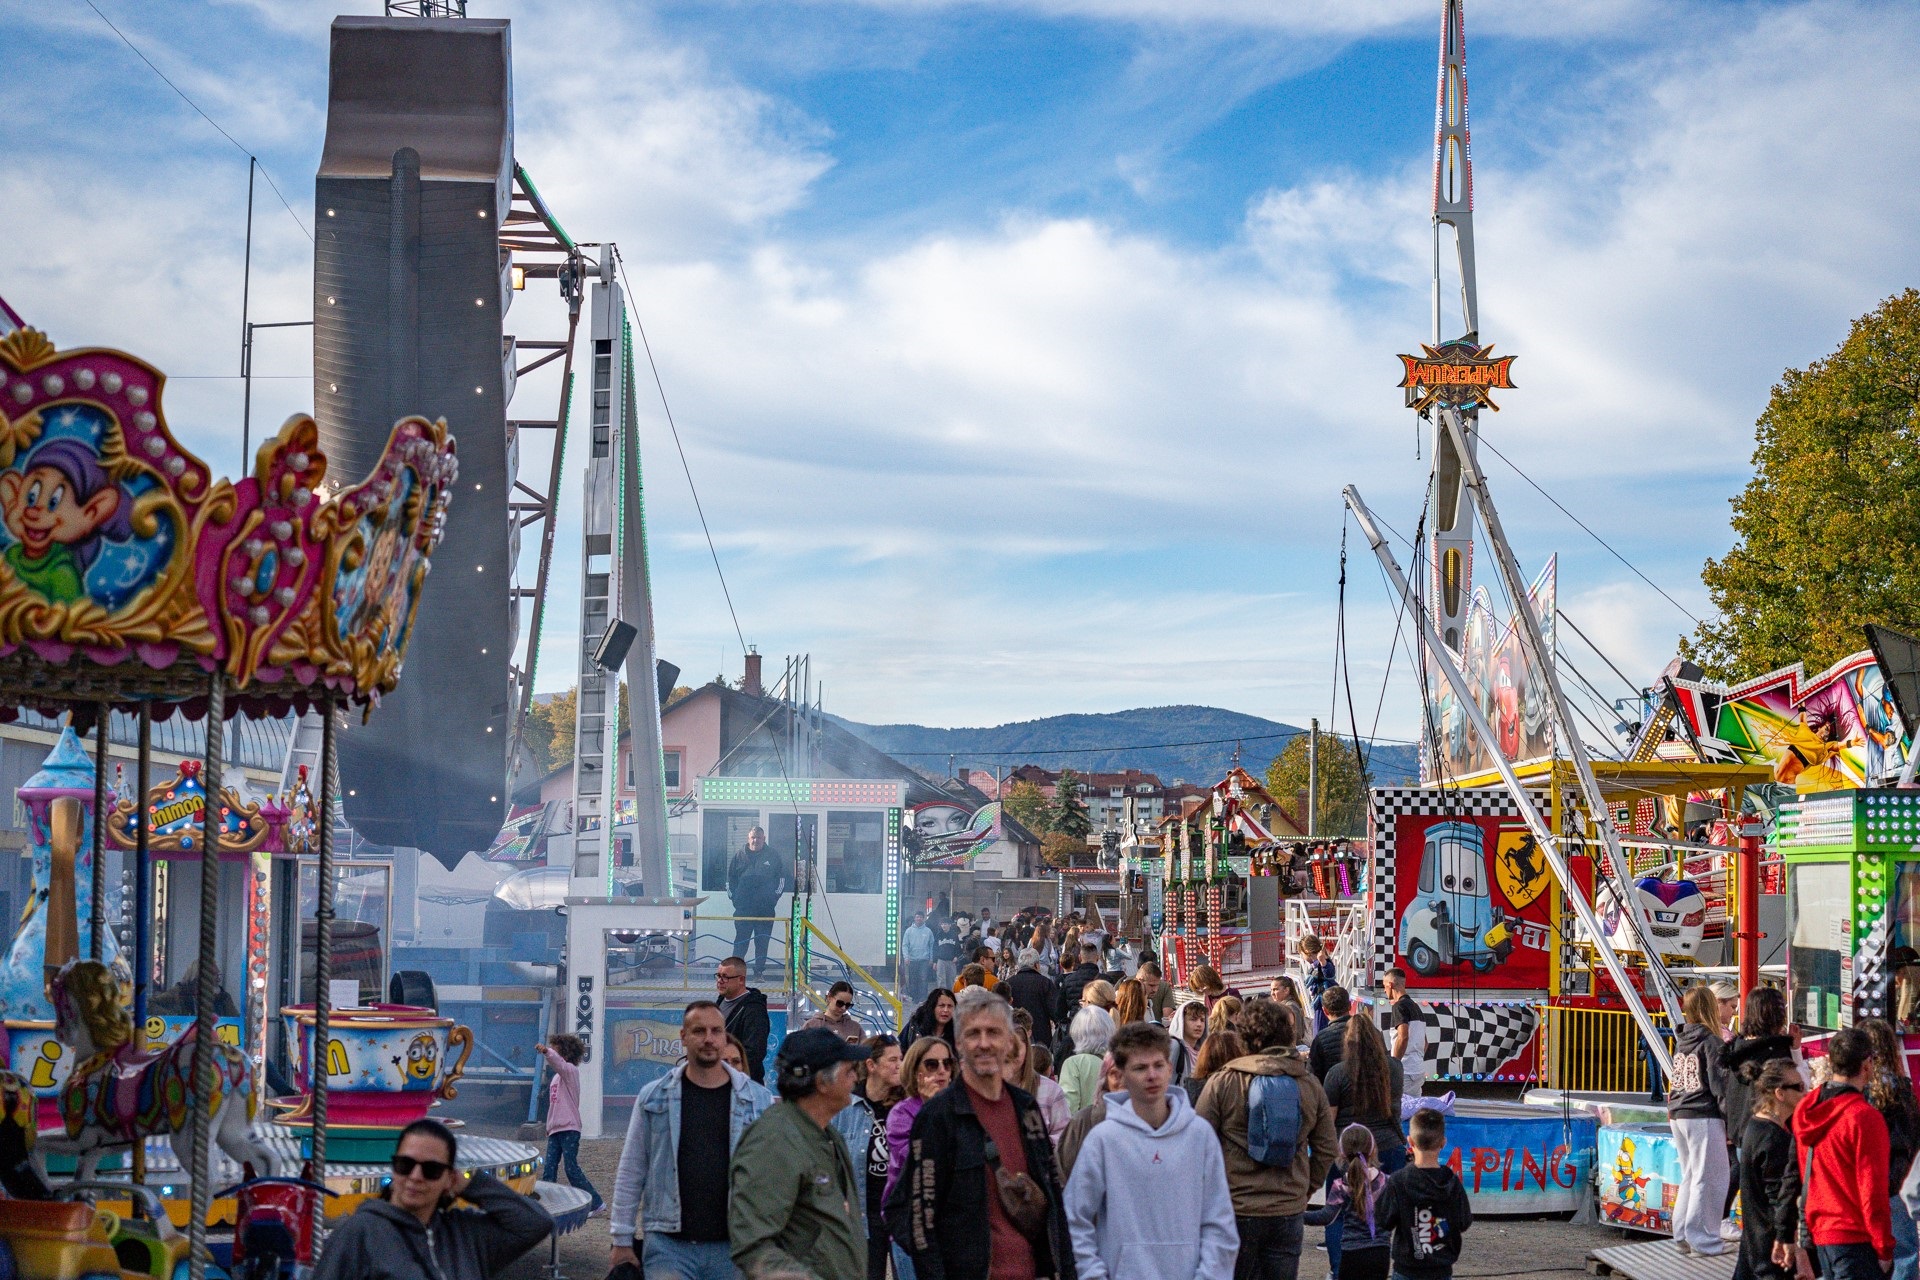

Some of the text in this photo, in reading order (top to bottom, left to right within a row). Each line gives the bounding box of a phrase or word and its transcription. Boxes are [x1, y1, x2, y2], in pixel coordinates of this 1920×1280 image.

[1404, 356, 1512, 388] IMPERIUM
[627, 1026, 684, 1057] PIRA
[868, 1161, 890, 1173] HO
[1418, 1206, 1434, 1255] ONIC
